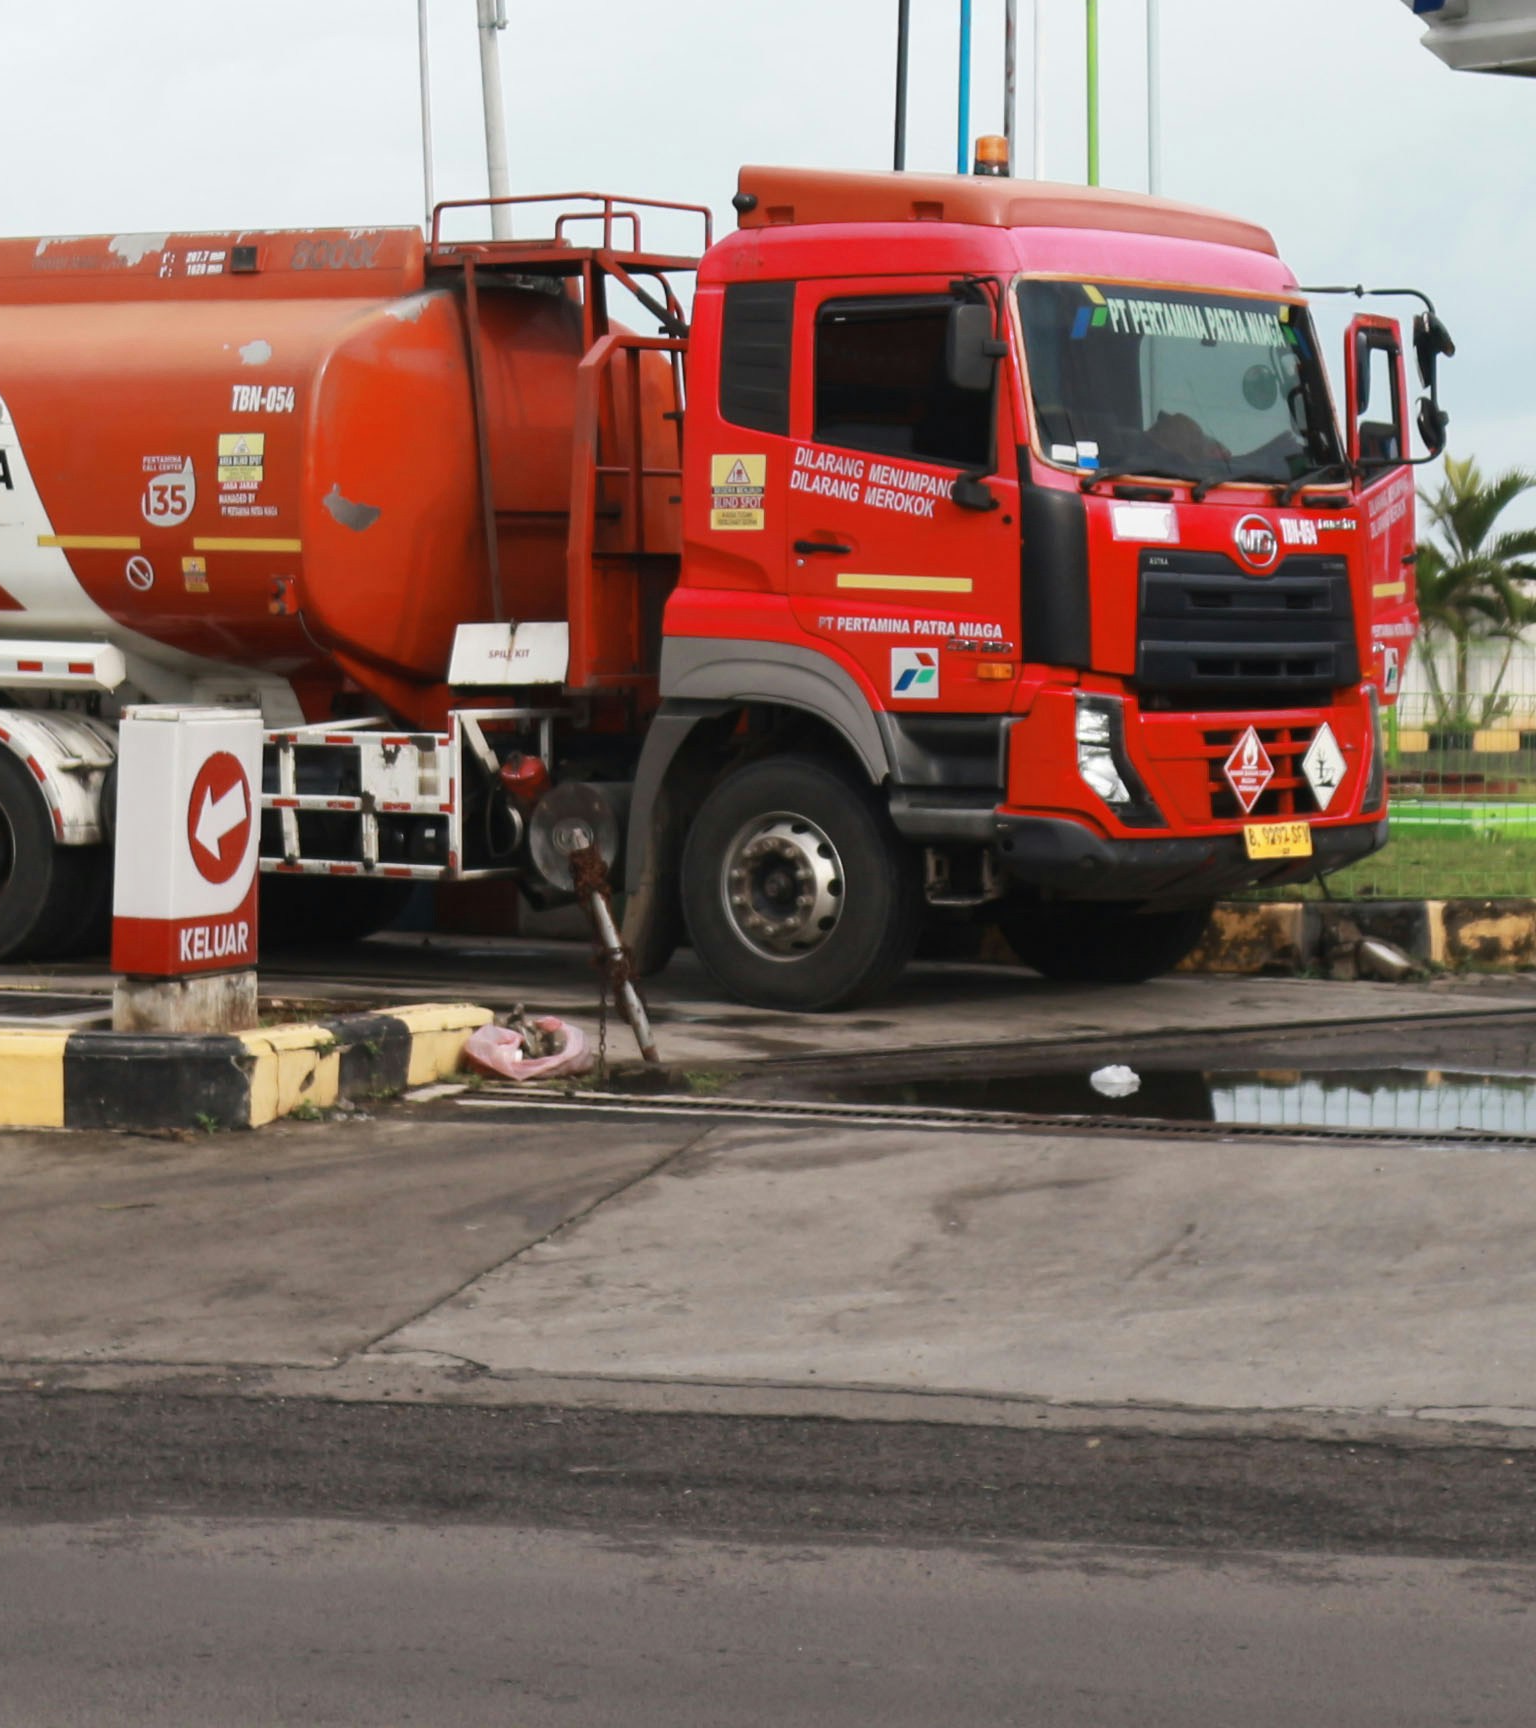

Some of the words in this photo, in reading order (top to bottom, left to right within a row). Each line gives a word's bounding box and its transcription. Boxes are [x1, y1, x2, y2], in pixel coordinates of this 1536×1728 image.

[1107, 298, 1130, 333] PT
[1128, 299, 1210, 340] PERTAMINA
[1205, 306, 1250, 344] PATRA
[1244, 311, 1286, 348] NIAGA
[231, 384, 296, 413] TBN-054
[794, 446, 864, 479] DILARANG
[145, 483, 187, 516] 135
[790, 470, 860, 502] DILARANG
[864, 486, 936, 518] MEROKOK
[818, 616, 834, 630] PT
[837, 617, 910, 633] PERTAMINA
[914, 620, 955, 636] PATRA
[959, 622, 1003, 638] NIAGA
[515, 649, 530, 658] KIT
[179, 921, 249, 962] KELUAR
